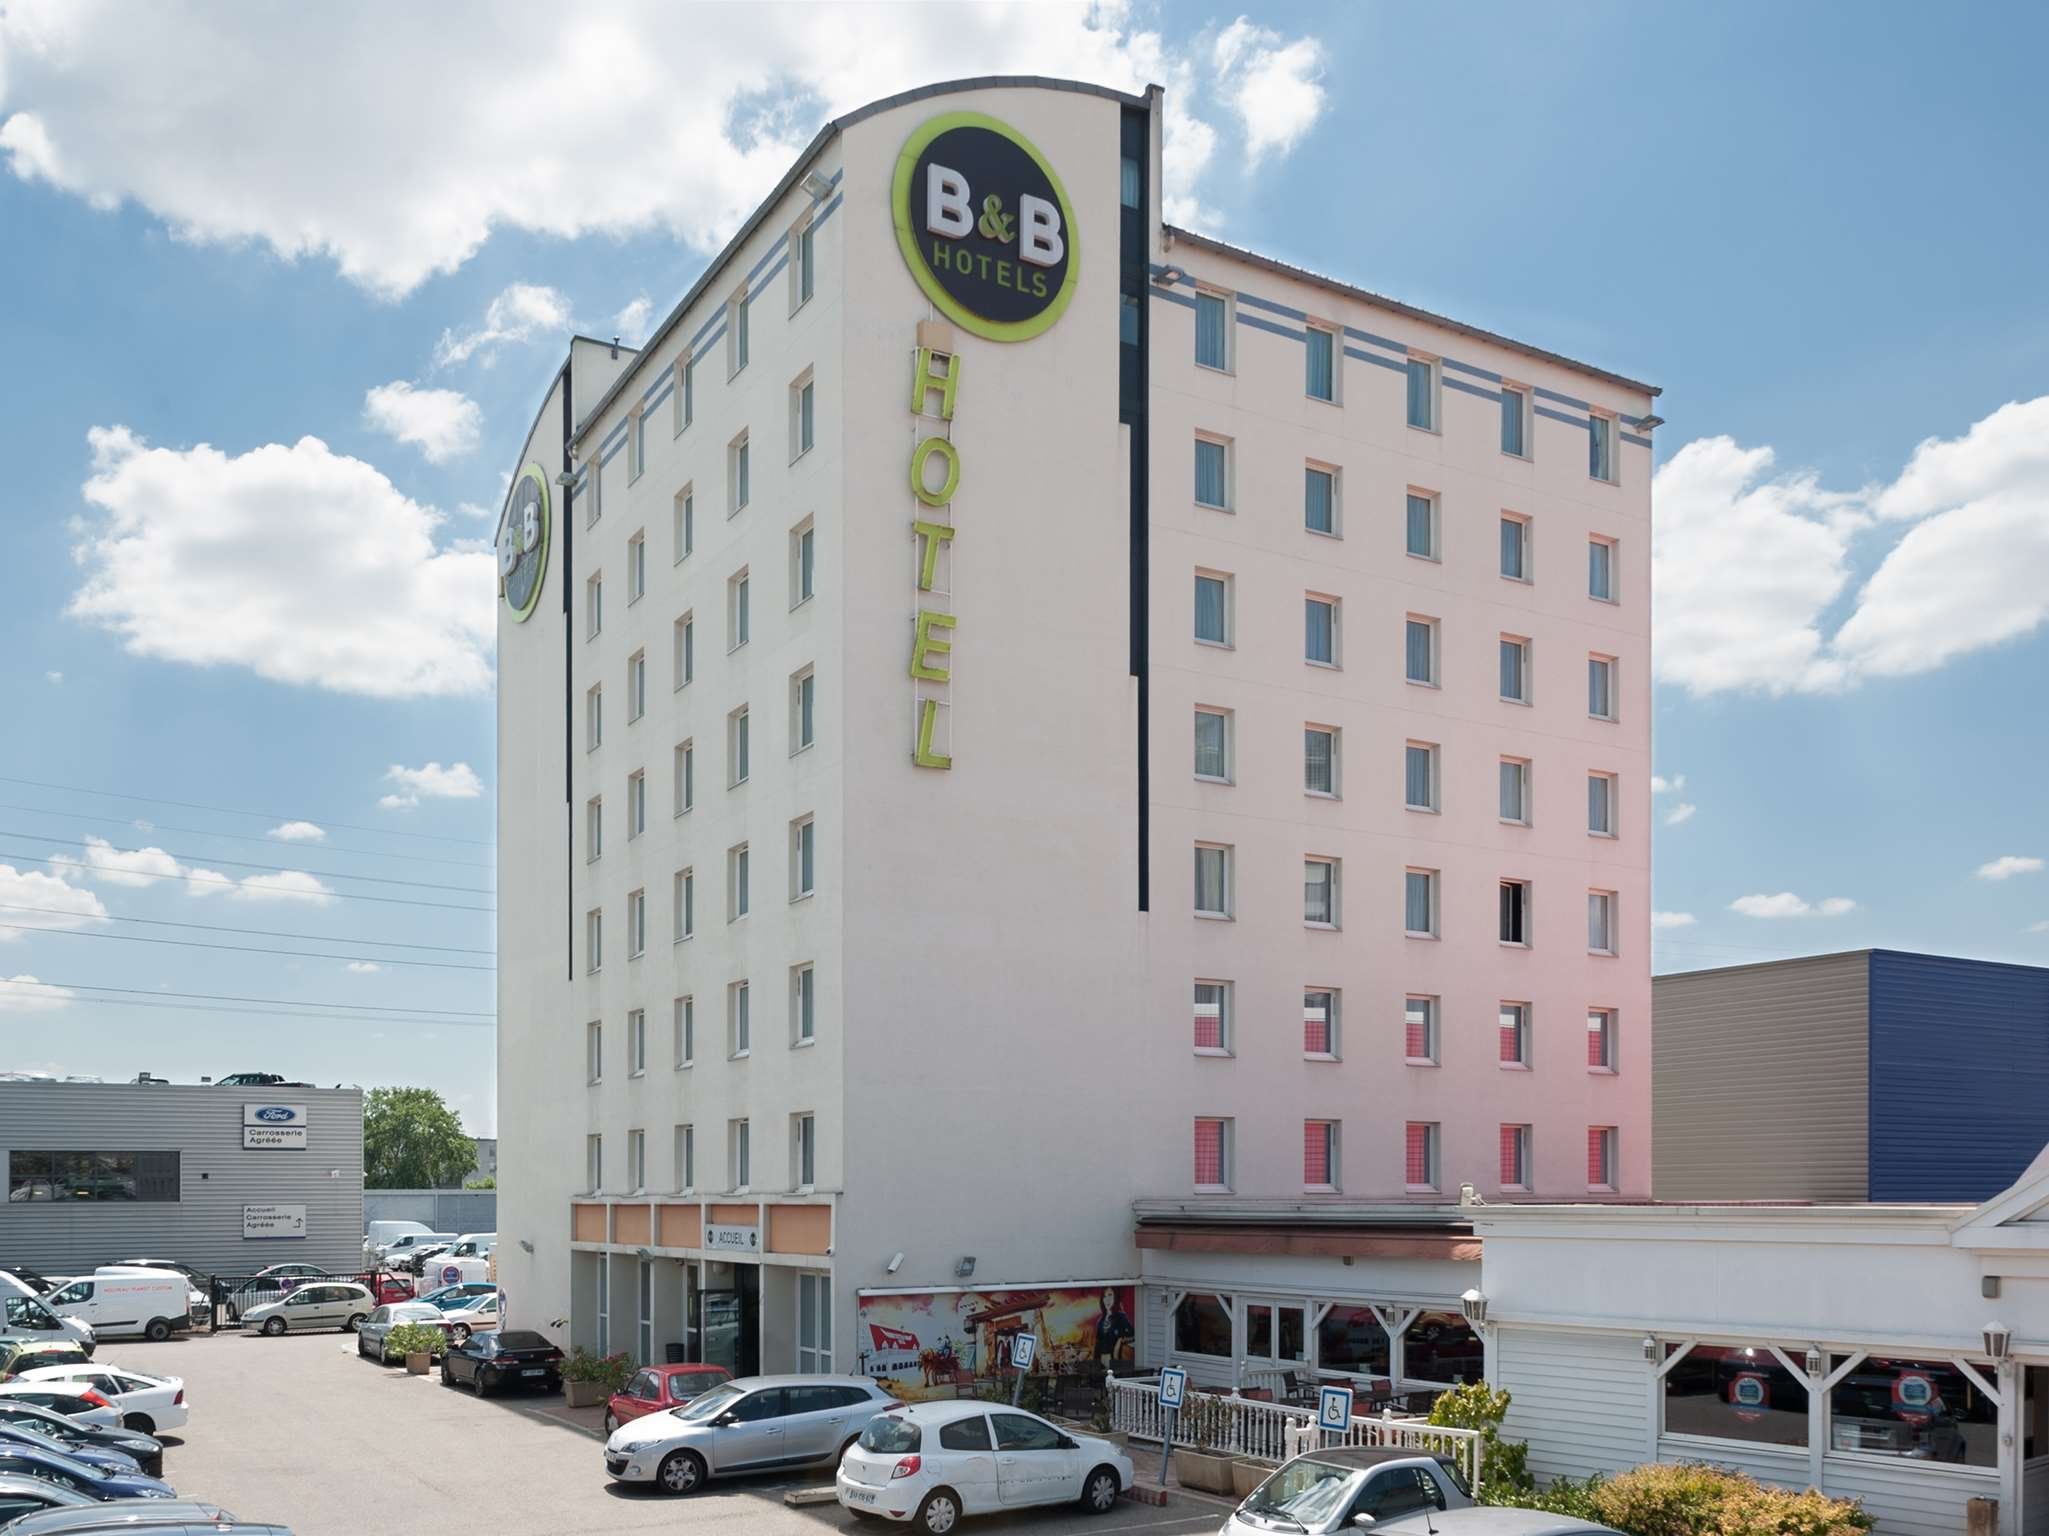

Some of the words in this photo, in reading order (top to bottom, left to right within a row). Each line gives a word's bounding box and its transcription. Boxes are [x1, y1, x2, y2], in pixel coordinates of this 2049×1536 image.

[926, 162, 1065, 268] B&B
[933, 240, 1048, 298] HOTELS
[911, 347, 961, 770] HOTEL
[249, 1129, 303, 1137] Carrosserie
[719, 1231, 745, 1246] ACCUEIL
